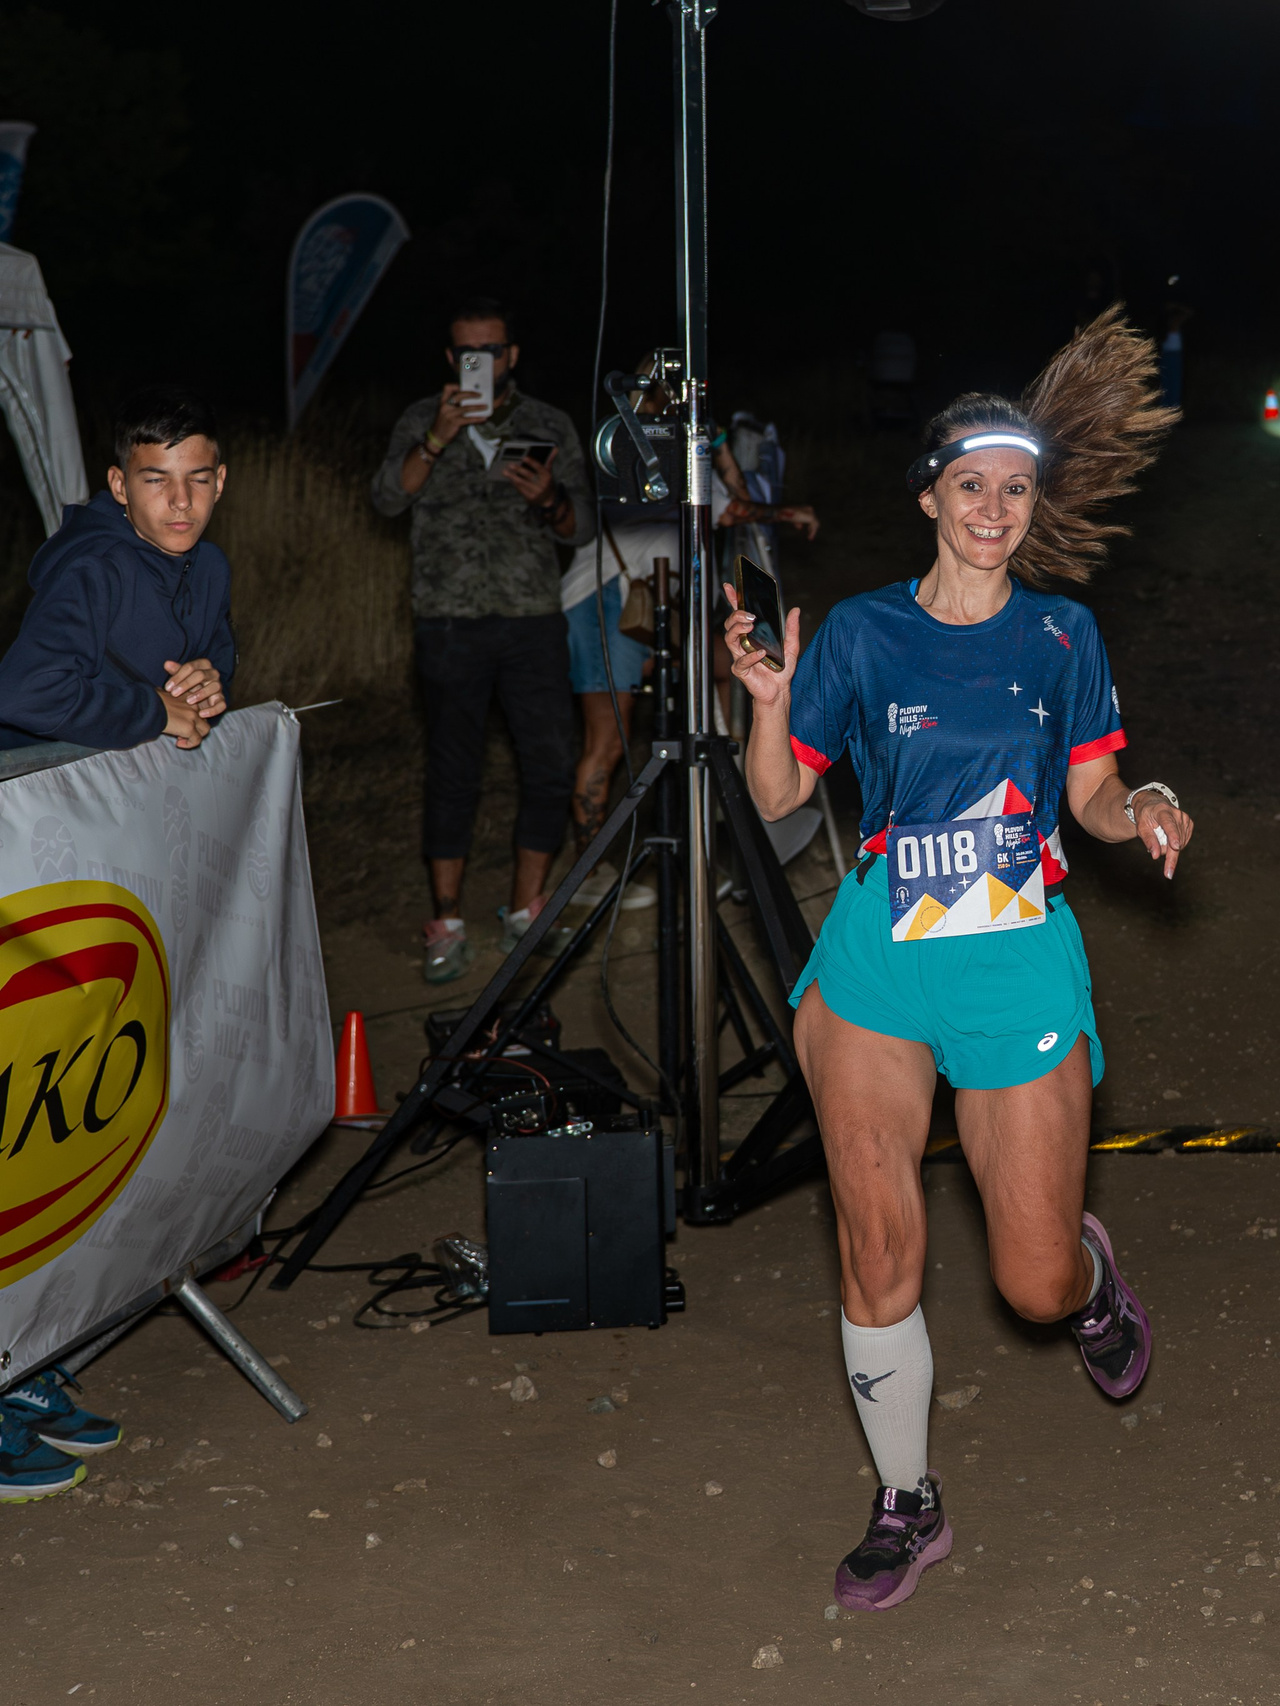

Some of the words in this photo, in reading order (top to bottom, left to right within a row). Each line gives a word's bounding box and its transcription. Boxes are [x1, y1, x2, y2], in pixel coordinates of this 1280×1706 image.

[1042, 615, 1062, 637] Night
[899, 705, 928, 716] PLOVDIV
[899, 714, 918, 724] HILLS
[899, 721, 921, 738] Night
[1005, 825, 1024, 833] PLOVDIV
[896, 830, 978, 880] 0118
[997, 853, 1009, 863] 6K
[218, 1124, 276, 1162] PLOVDIV
[197, 1165, 241, 1198] HILLS
